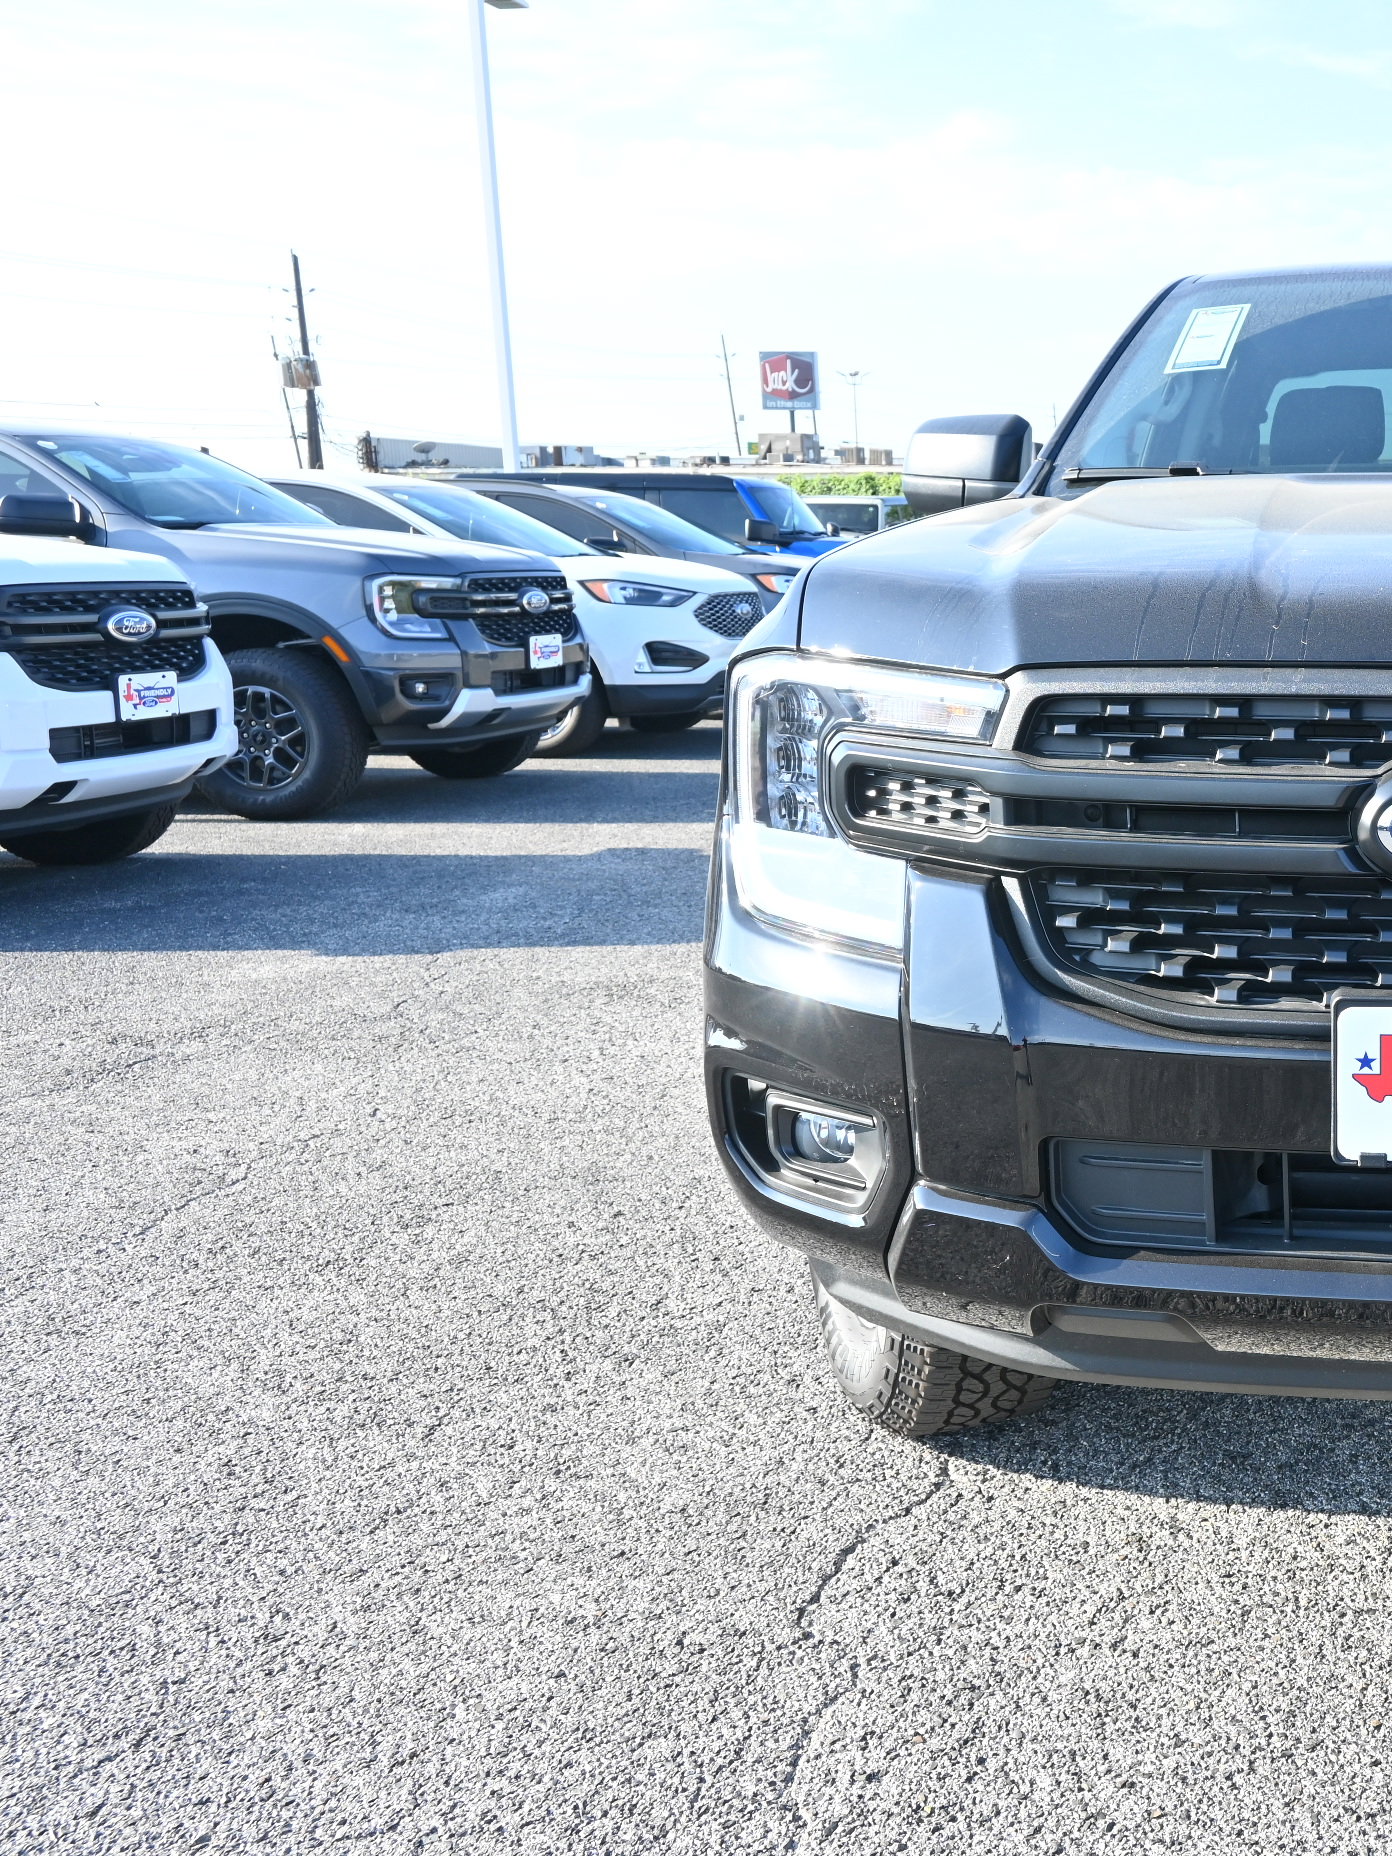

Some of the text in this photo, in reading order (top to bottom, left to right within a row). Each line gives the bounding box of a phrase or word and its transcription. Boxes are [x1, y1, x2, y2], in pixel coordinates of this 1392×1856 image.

[763, 359, 812, 393] Jack
[766, 400, 811, 408] in the box
[122, 617, 148, 633] Ford
[140, 687, 172, 697] FRIENDLY
